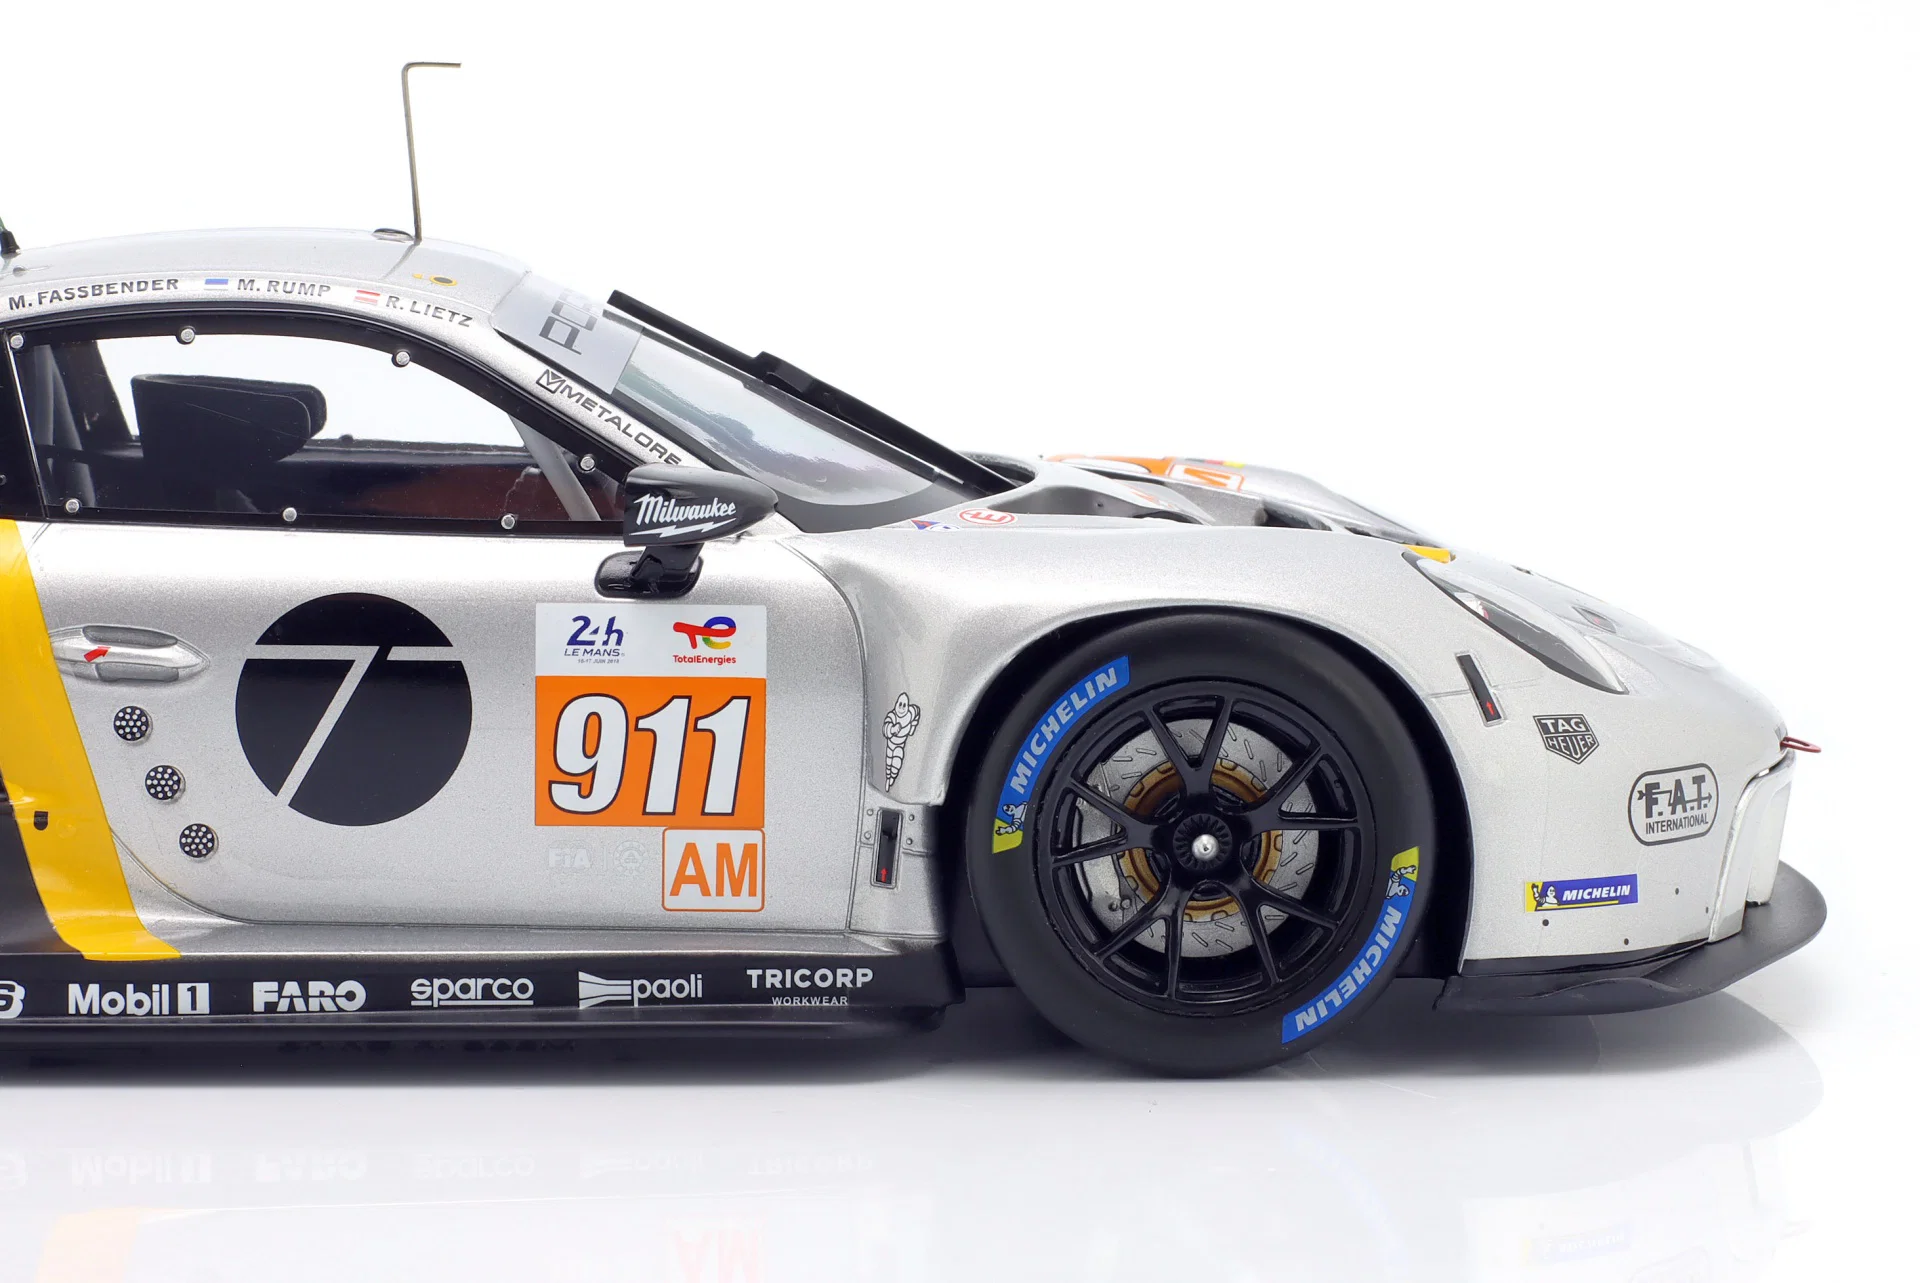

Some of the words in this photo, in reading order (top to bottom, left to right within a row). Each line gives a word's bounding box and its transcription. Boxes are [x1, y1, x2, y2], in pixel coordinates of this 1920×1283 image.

[8, 295, 33, 310] M.
[38, 278, 180, 305] FASSBENDER
[236, 278, 261, 292] M.
[266, 280, 331, 298] RUMP
[385, 295, 404, 310] R.
[409, 300, 474, 328] LIETZ
[559, 384, 682, 466] METALORE
[634, 493, 737, 526] Milwaukee
[564, 648, 581, 656] LE
[582, 648, 620, 657] MANS
[672, 655, 737, 666] TotalEnergies
[1010, 667, 1118, 795] MICHELIN
[1540, 719, 1587, 733] TAG
[548, 693, 752, 817] 911
[1547, 735, 1595, 758] HEUER
[1645, 812, 1709, 835] INTERNATIONAL
[669, 842, 758, 898] AM
[1562, 884, 1631, 901] MICHELIN
[747, 968, 873, 988] TRICORP
[1295, 905, 1402, 1032] MICHELIN
[68, 983, 169, 1016] Mobil
[178, 983, 210, 1014] 1
[253, 980, 367, 1012] FARO
[410, 977, 535, 1006] sparco
[633, 974, 703, 1007] paoli
[771, 996, 848, 1006] WORKWEAR
